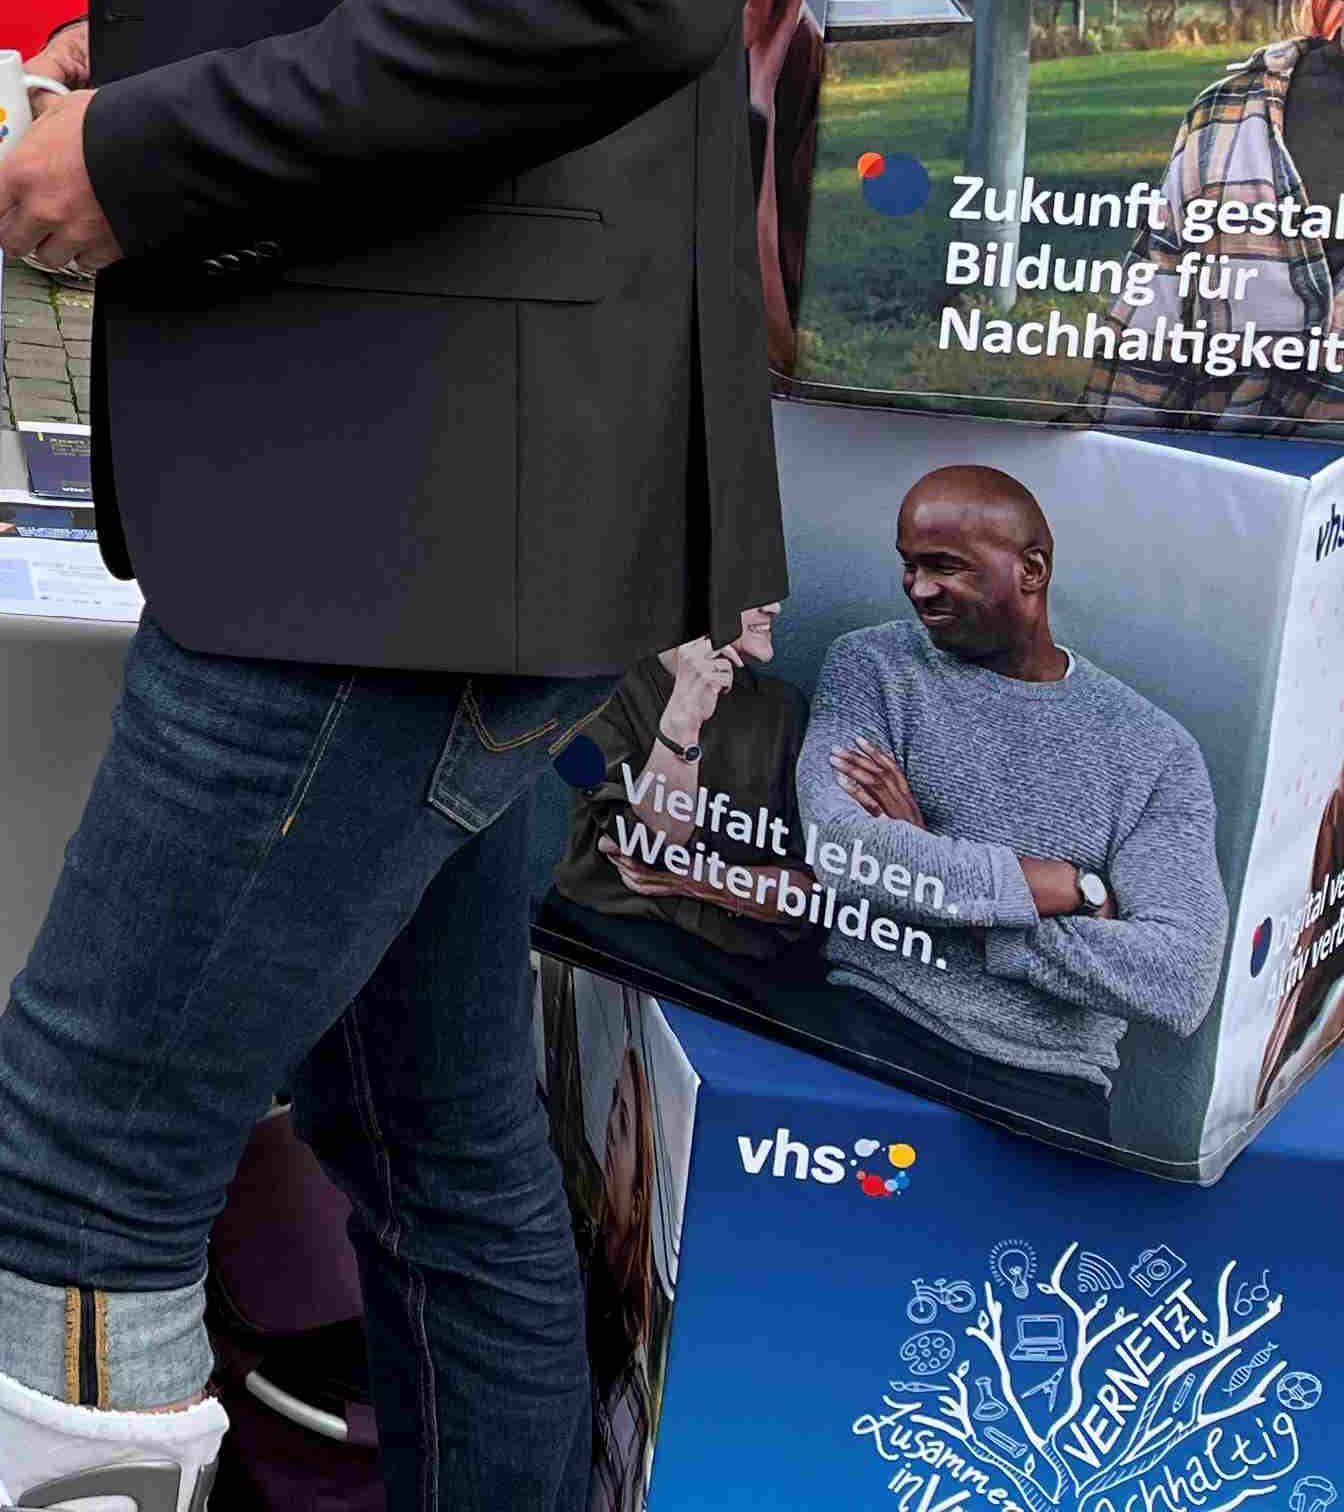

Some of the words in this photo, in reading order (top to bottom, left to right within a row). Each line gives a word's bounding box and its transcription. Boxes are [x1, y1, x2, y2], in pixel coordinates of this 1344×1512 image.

[949, 175, 1166, 231] Zukunft
[945, 241, 1157, 302] Bildung
[1176, 251, 1259, 301] für
[938, 306, 1344, 376] Nachhaltigkeit
[620, 761, 789, 854] Vielfalt
[804, 821, 961, 916] leben.
[615, 814, 948, 971] Weiterbilden.
[737, 1128, 846, 1184] vhs
[1063, 1279, 1210, 1470] VERNETZT
